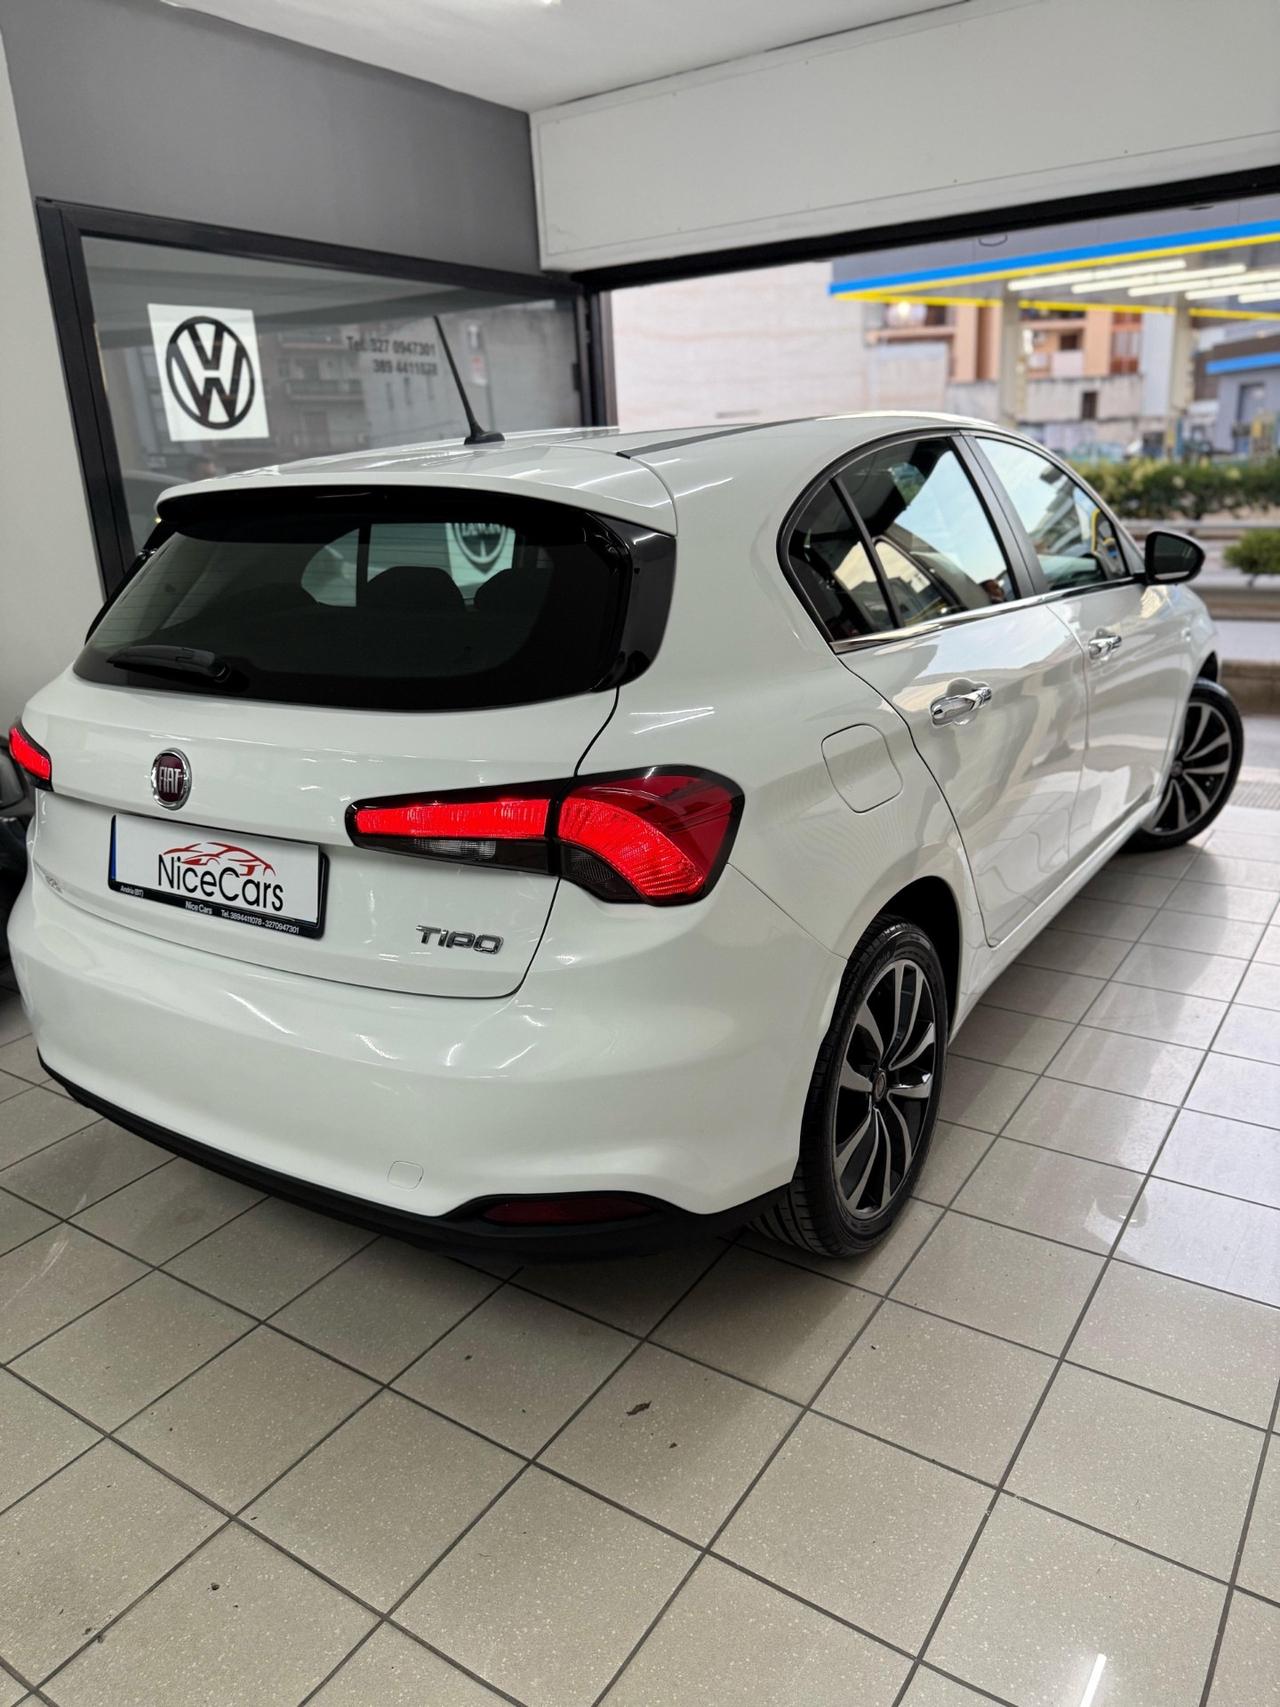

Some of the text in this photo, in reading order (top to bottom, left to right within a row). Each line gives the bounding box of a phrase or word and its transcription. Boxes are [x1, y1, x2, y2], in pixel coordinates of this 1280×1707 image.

[159, 766, 182, 794] FIAT
[158, 853, 284, 912] NiceCars
[185, 901, 198, 912] Nice
[199, 904, 213, 915] Cars
[265, 920, 299, 934] 3270947301
[416, 925, 504, 955] TIPO
